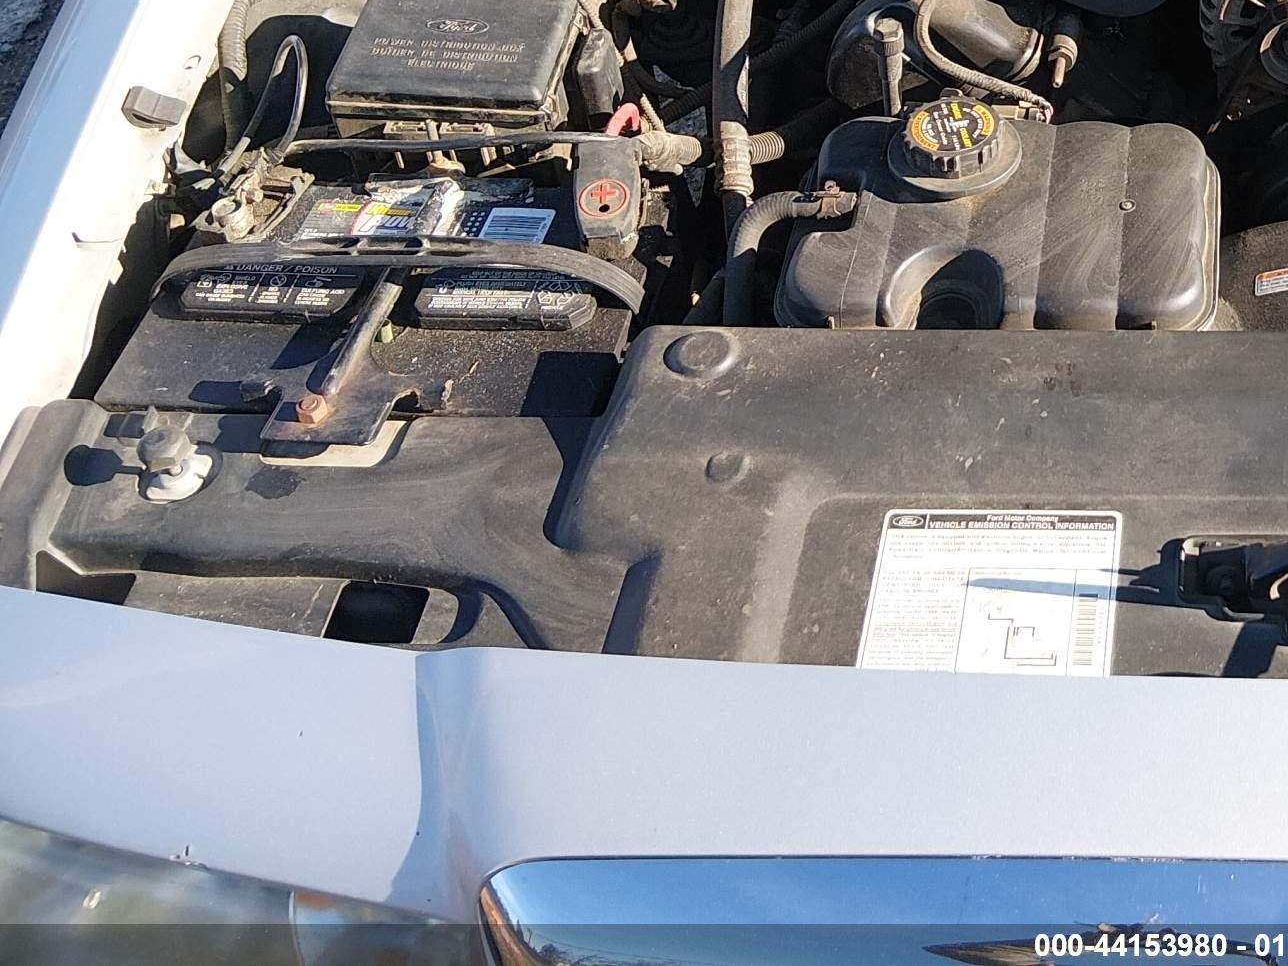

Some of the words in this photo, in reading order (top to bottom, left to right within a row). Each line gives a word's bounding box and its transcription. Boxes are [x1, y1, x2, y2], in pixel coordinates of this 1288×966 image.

[374, 37, 414, 47] POWER
[421, 40, 496, 51] DISTRIBUTION
[421, 49, 436, 58] DE
[442, 50, 518, 63] DISTRIBUTION
[236, 264, 283, 272] DANGER
[294, 265, 338, 274] POISON
[987, 514, 1003, 522] Ford
[1004, 514, 1025, 522] Motor
[1026, 515, 1059, 523] Company
[929, 521, 966, 529] VEHICLE
[968, 521, 1010, 529] EMISSION
[1011, 521, 1053, 530] CONTROL
[1055, 522, 1114, 530] INFORMATION
